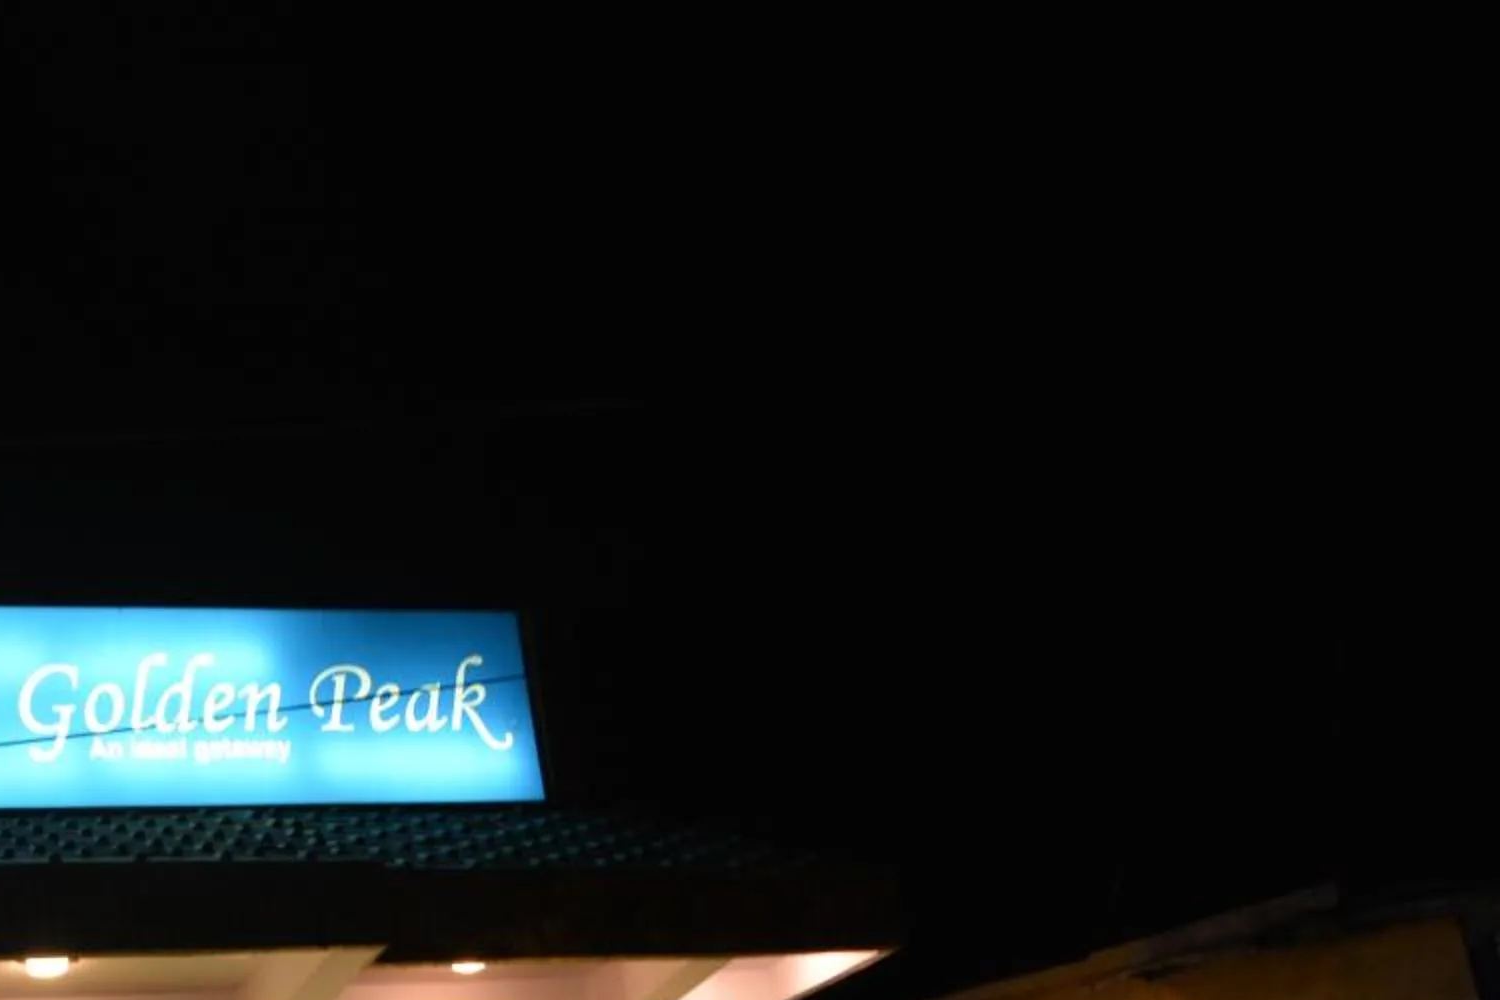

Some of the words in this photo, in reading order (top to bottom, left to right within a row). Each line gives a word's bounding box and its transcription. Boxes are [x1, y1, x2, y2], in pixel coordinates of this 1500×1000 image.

[17, 652, 288, 763] Golden
[309, 653, 514, 751] Peak
[90, 735, 123, 760] An
